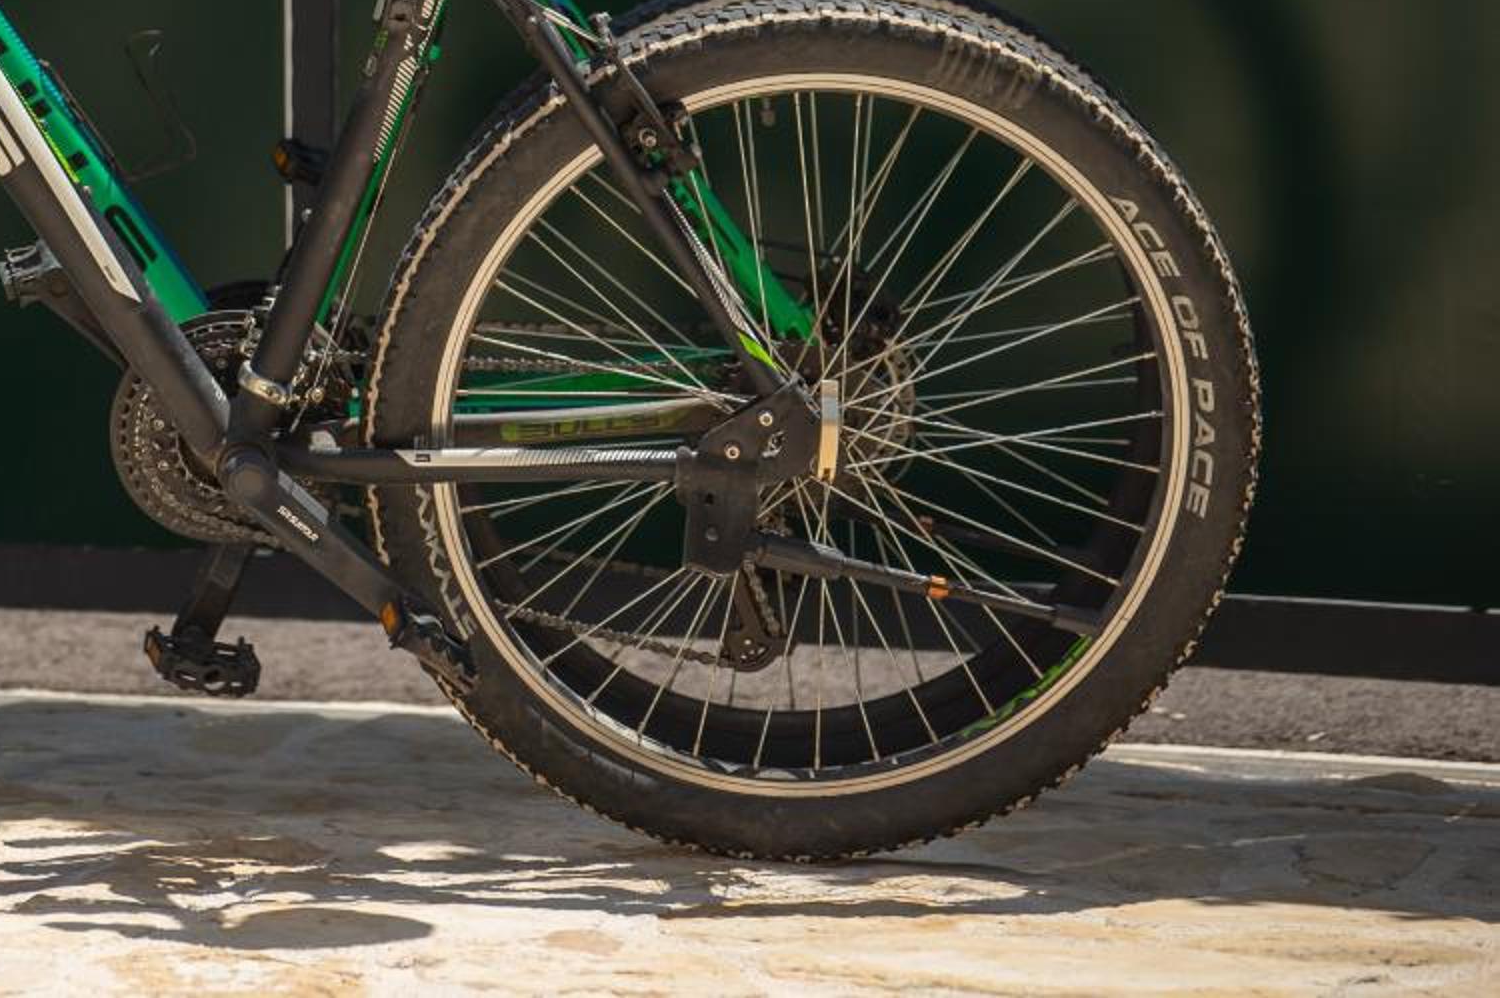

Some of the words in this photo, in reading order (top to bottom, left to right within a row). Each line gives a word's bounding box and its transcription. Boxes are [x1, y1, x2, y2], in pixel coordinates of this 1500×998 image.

[1107, 195, 1182, 279] ACE
[1170, 294, 1209, 362] OF
[1185, 377, 1216, 520] PACE
